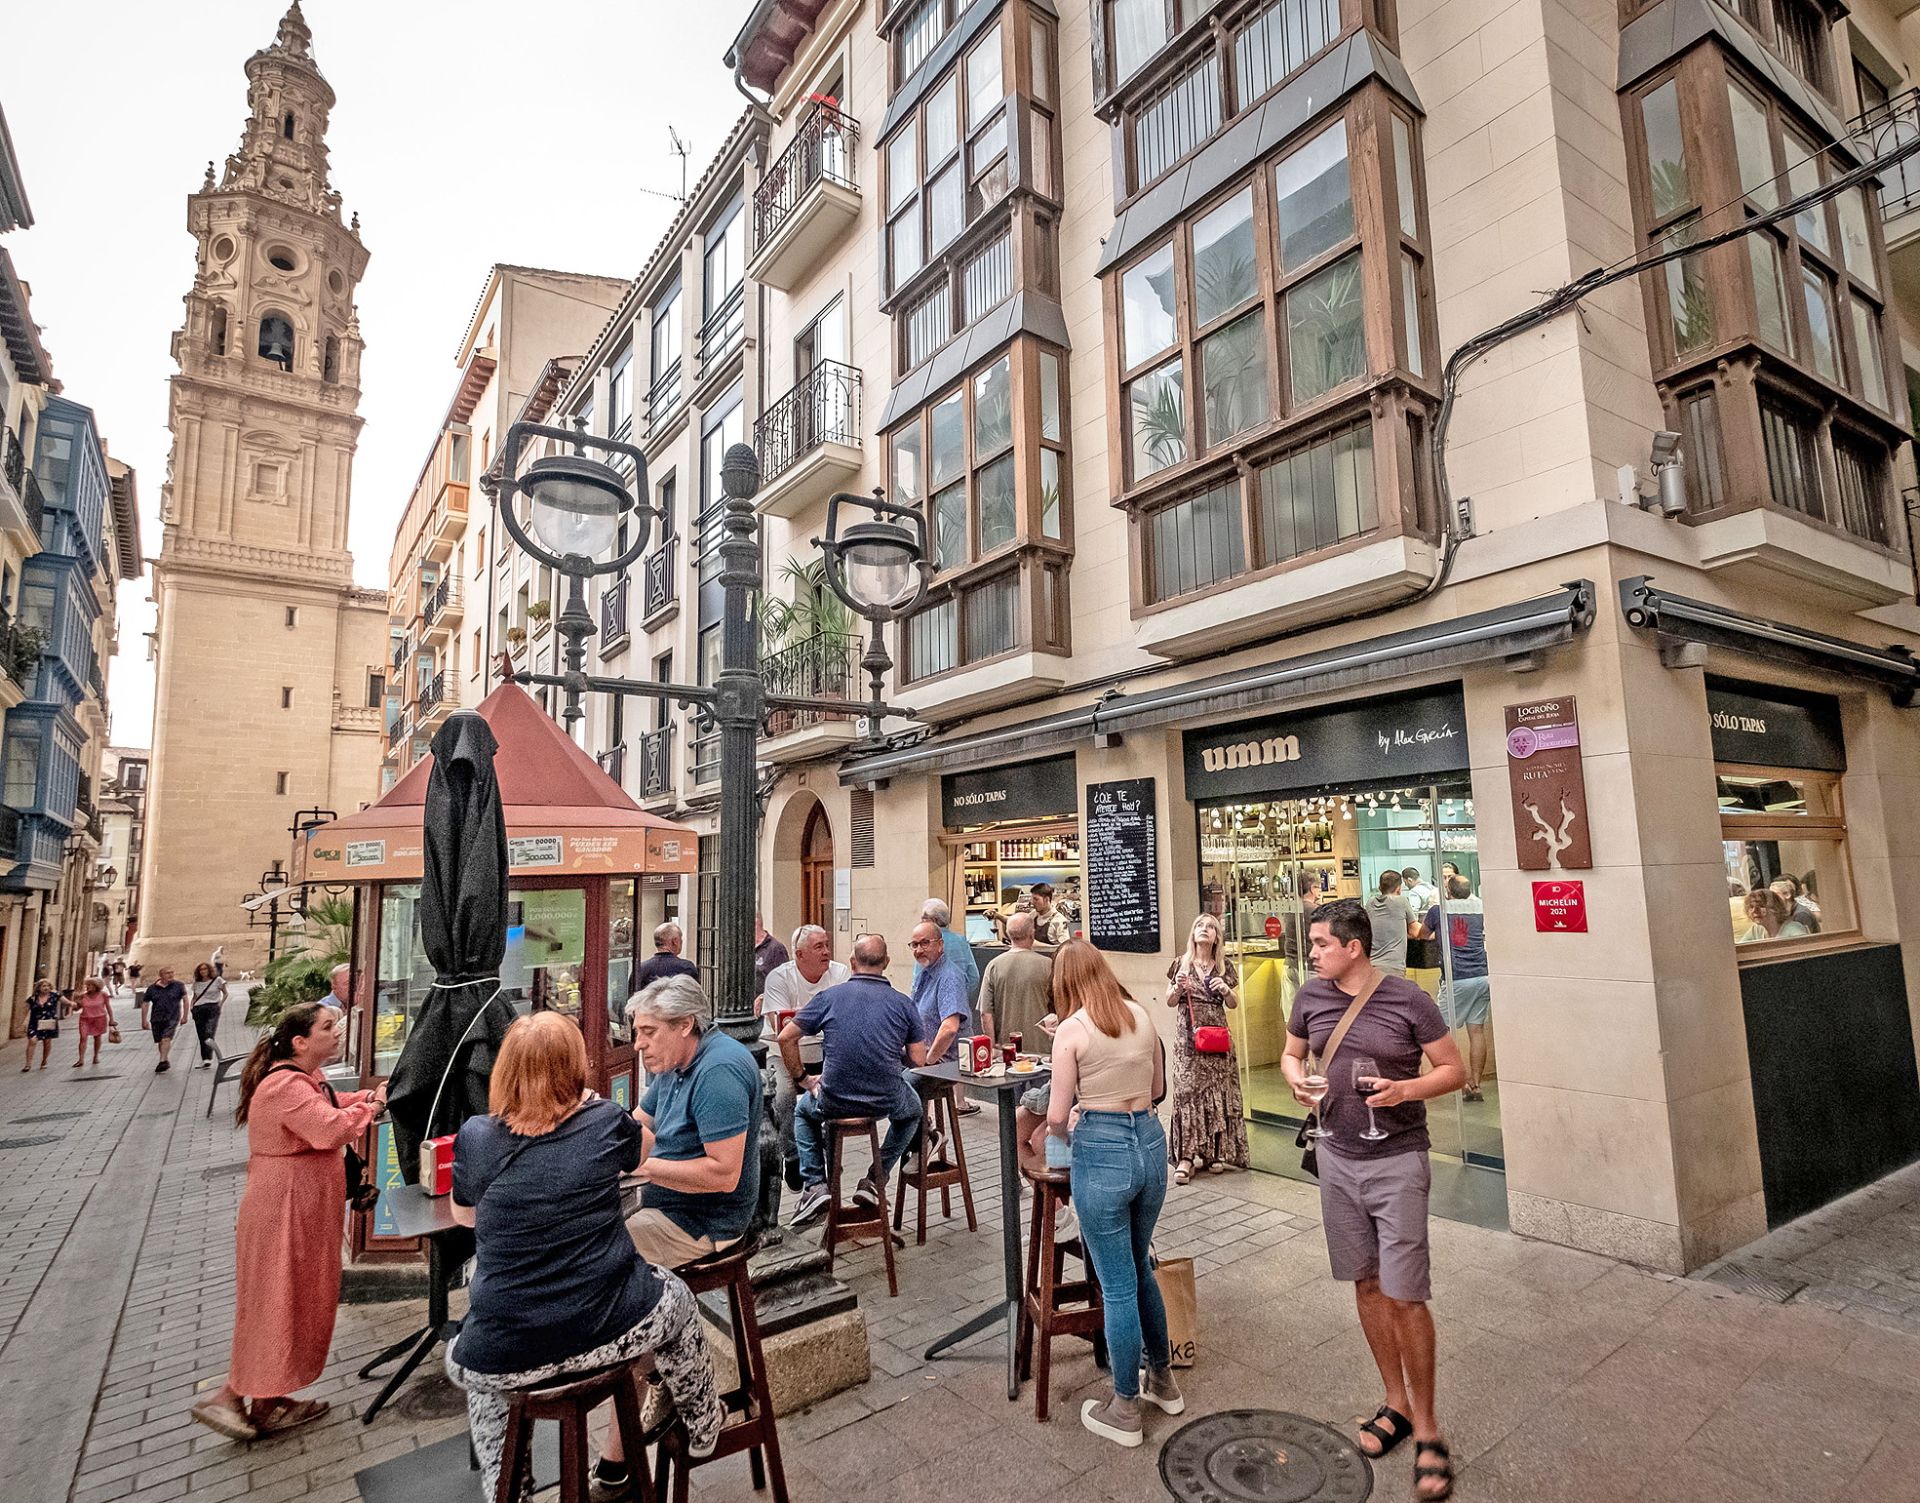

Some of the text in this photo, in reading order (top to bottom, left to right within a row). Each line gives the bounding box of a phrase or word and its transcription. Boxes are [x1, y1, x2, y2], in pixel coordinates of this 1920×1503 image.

[1517, 703, 1560, 718] LOGROÑO
[1713, 711, 1739, 730] SÓLO
[1739, 716, 1766, 734] TAPAS
[1378, 730, 1390, 754] by
[1523, 771, 1549, 781] RUTA
[953, 789, 1007, 807] NO SÓLO TAPAS
[1116, 790, 1127, 801] TE
[1538, 898, 1578, 906] MICHELIN
[1550, 907, 1567, 915] 2021
